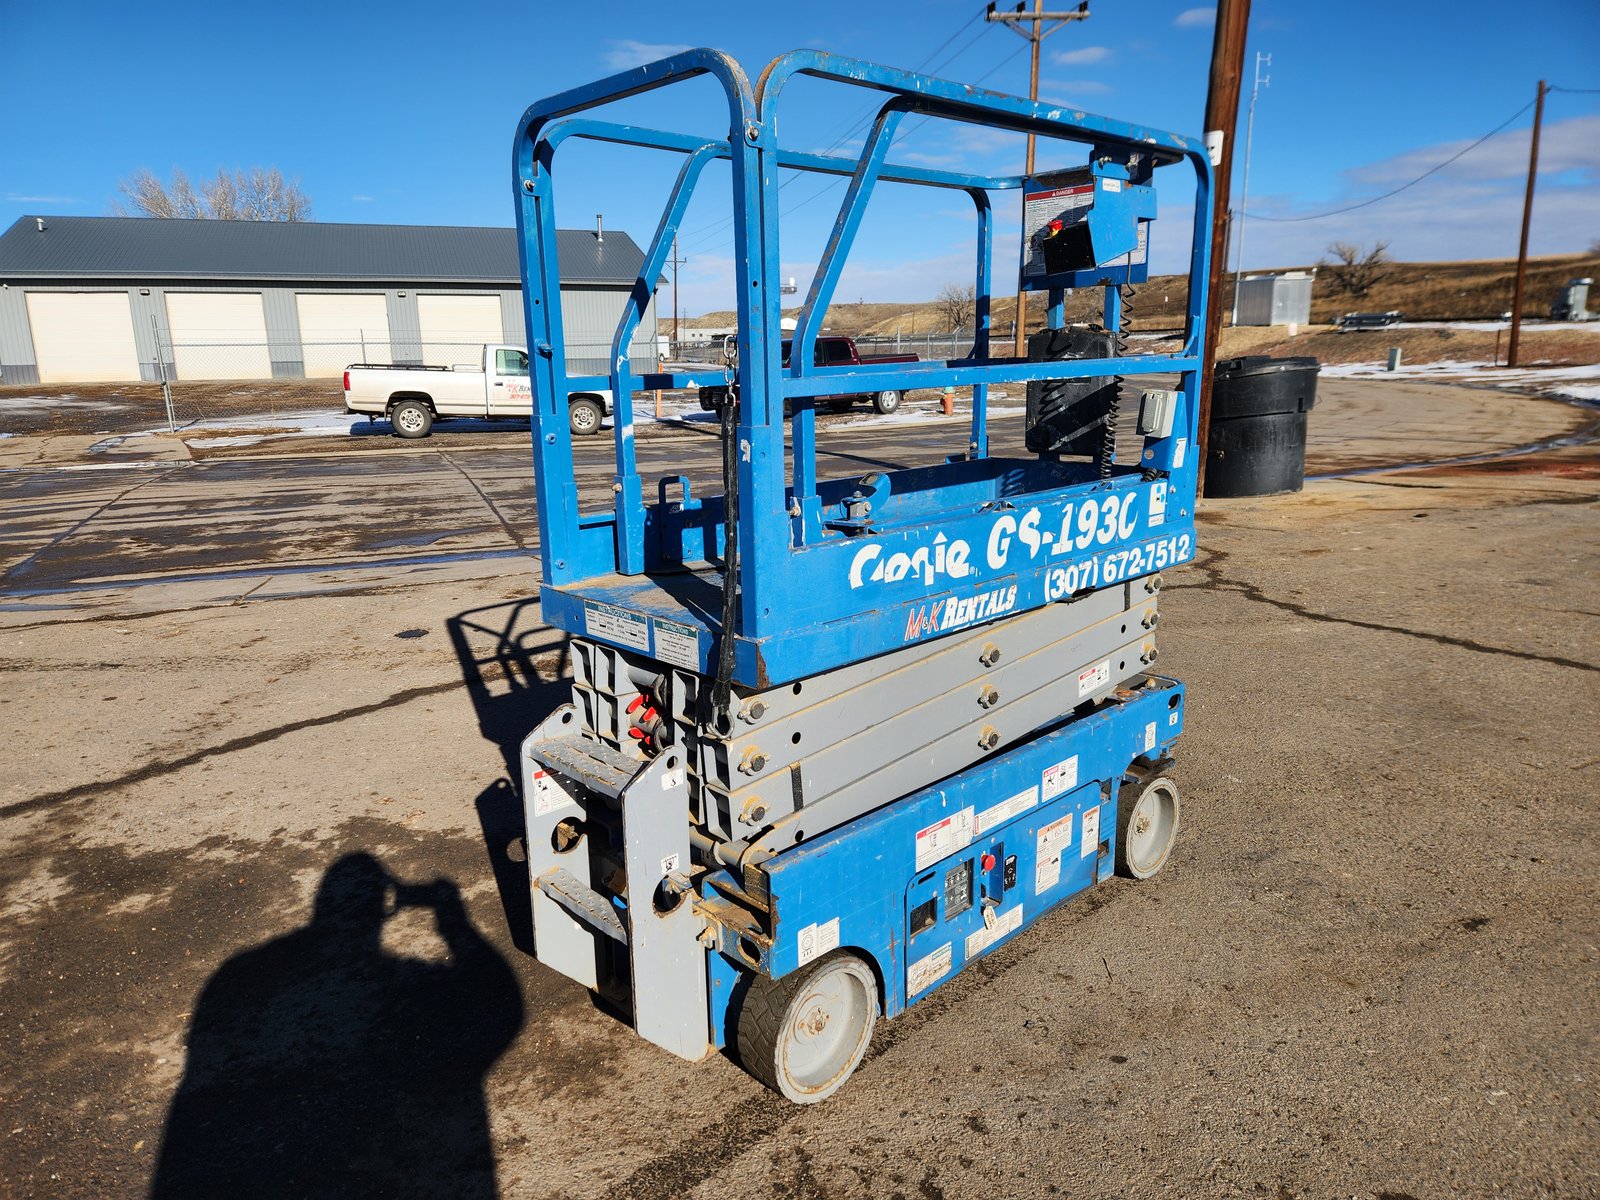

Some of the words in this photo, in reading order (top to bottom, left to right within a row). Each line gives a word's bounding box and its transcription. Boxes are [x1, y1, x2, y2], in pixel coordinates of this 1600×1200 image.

[1056, 188, 1074, 196] DANGER
[1044, 556, 1099, 603] (307)
[1103, 533, 1190, 583] 672-7512
